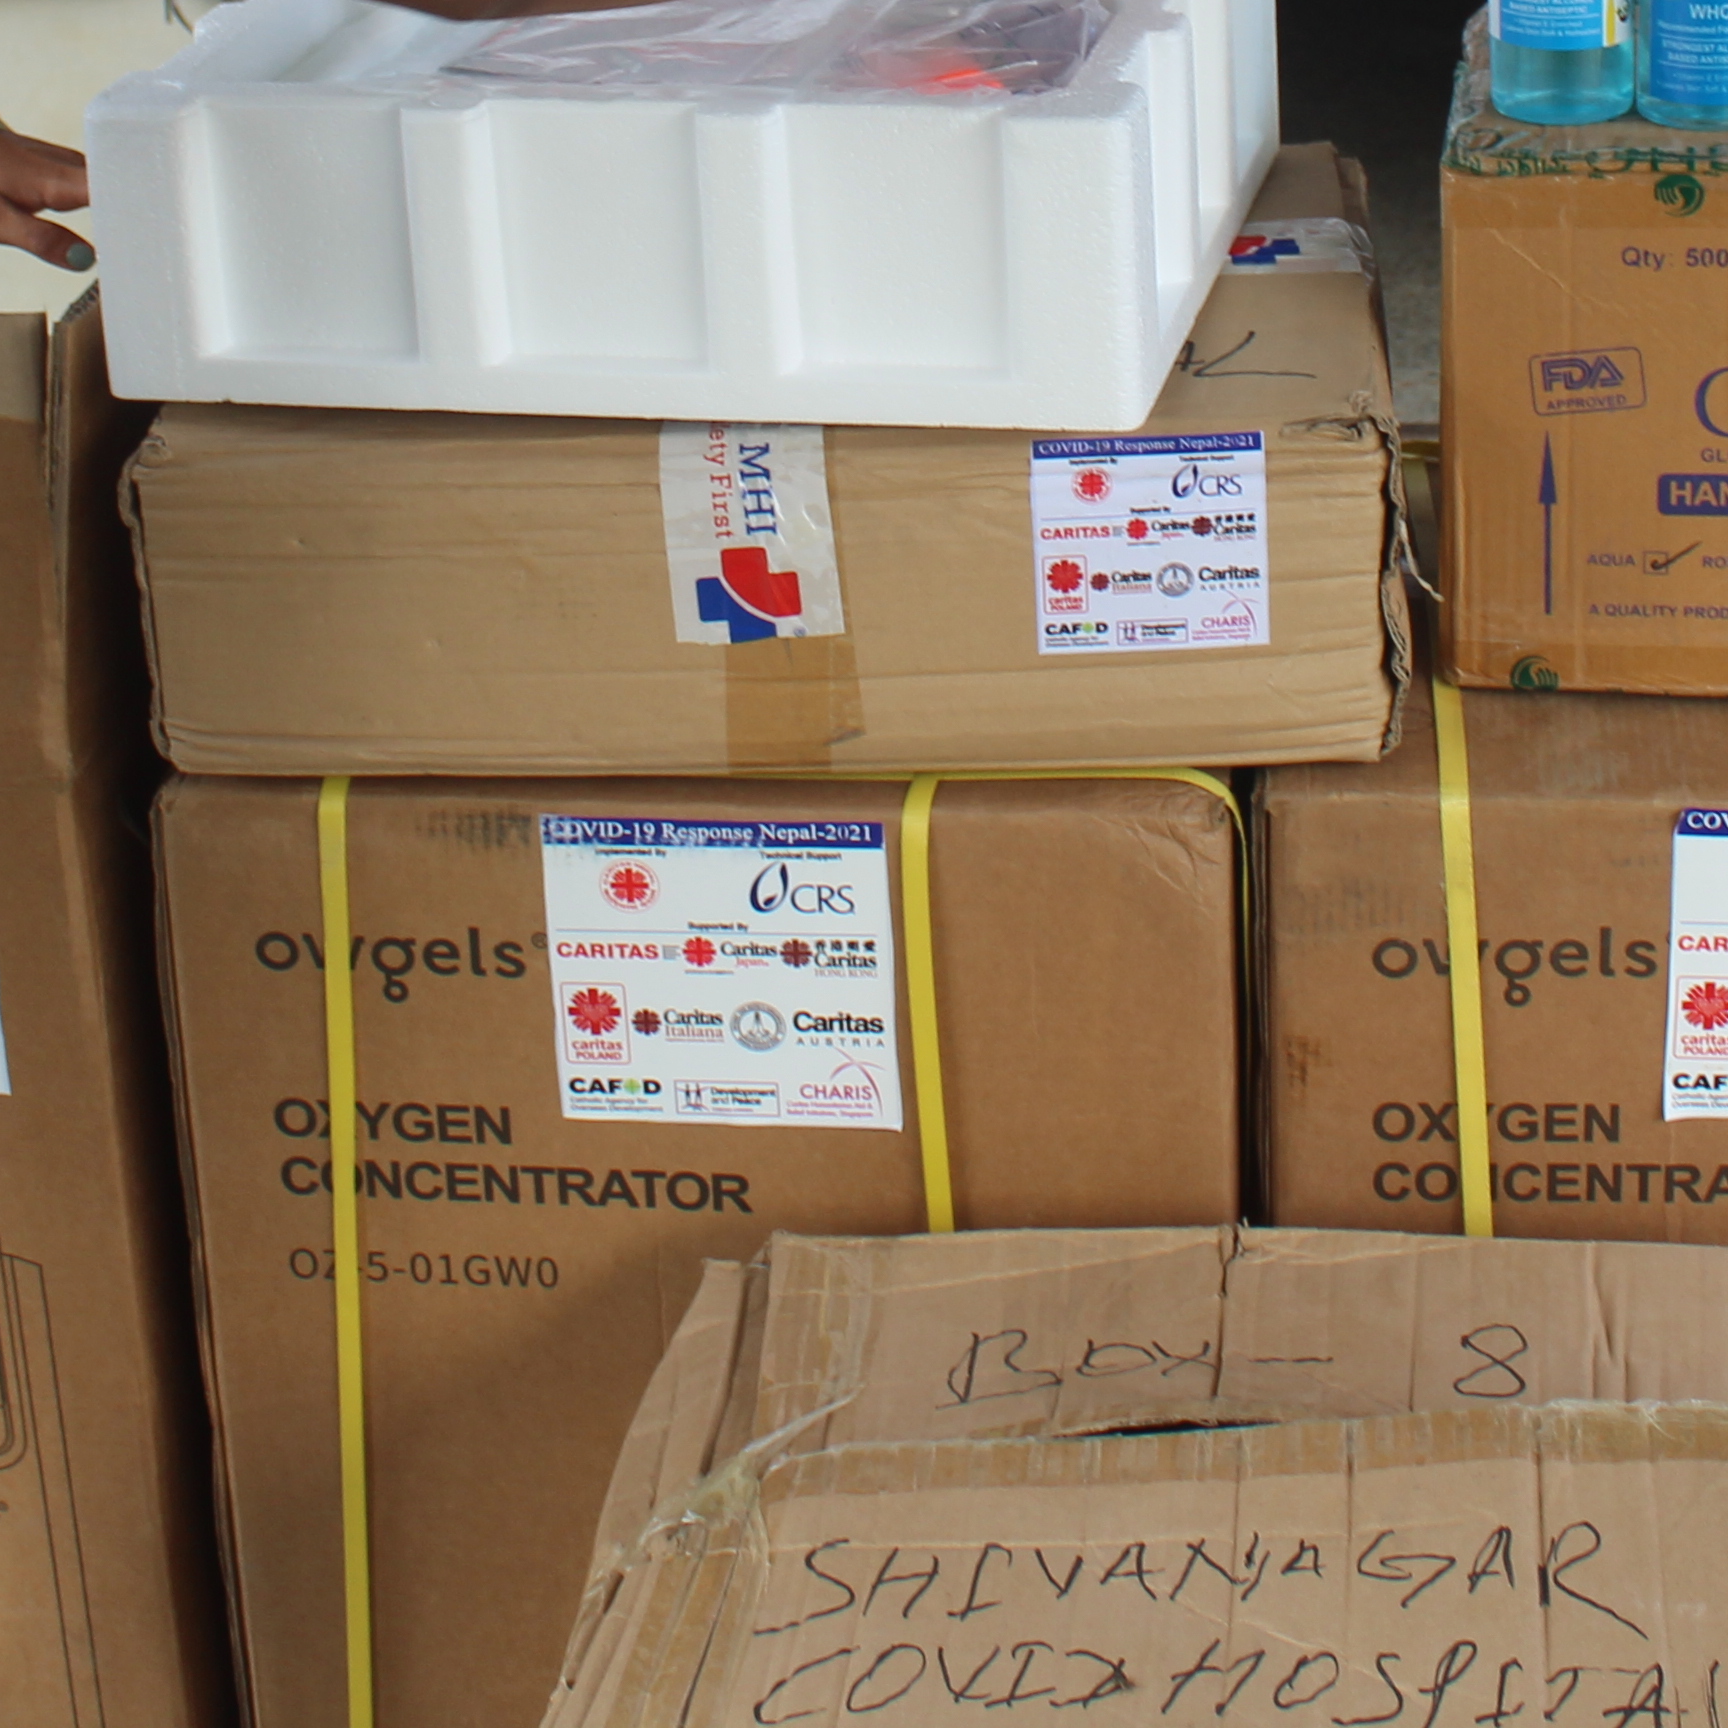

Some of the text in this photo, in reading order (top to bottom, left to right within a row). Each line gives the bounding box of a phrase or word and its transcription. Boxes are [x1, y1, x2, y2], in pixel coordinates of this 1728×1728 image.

[1541, 354, 1626, 392] FDA
[1546, 394, 1628, 412] APPROVED
[709, 473, 734, 539] First
[738, 442, 777, 537] MHI
[1586, 552, 1636, 569] AQUA
[1373, 1102, 1621, 1143] OXGEN
[1453, 1322, 1530, 1402] 8
